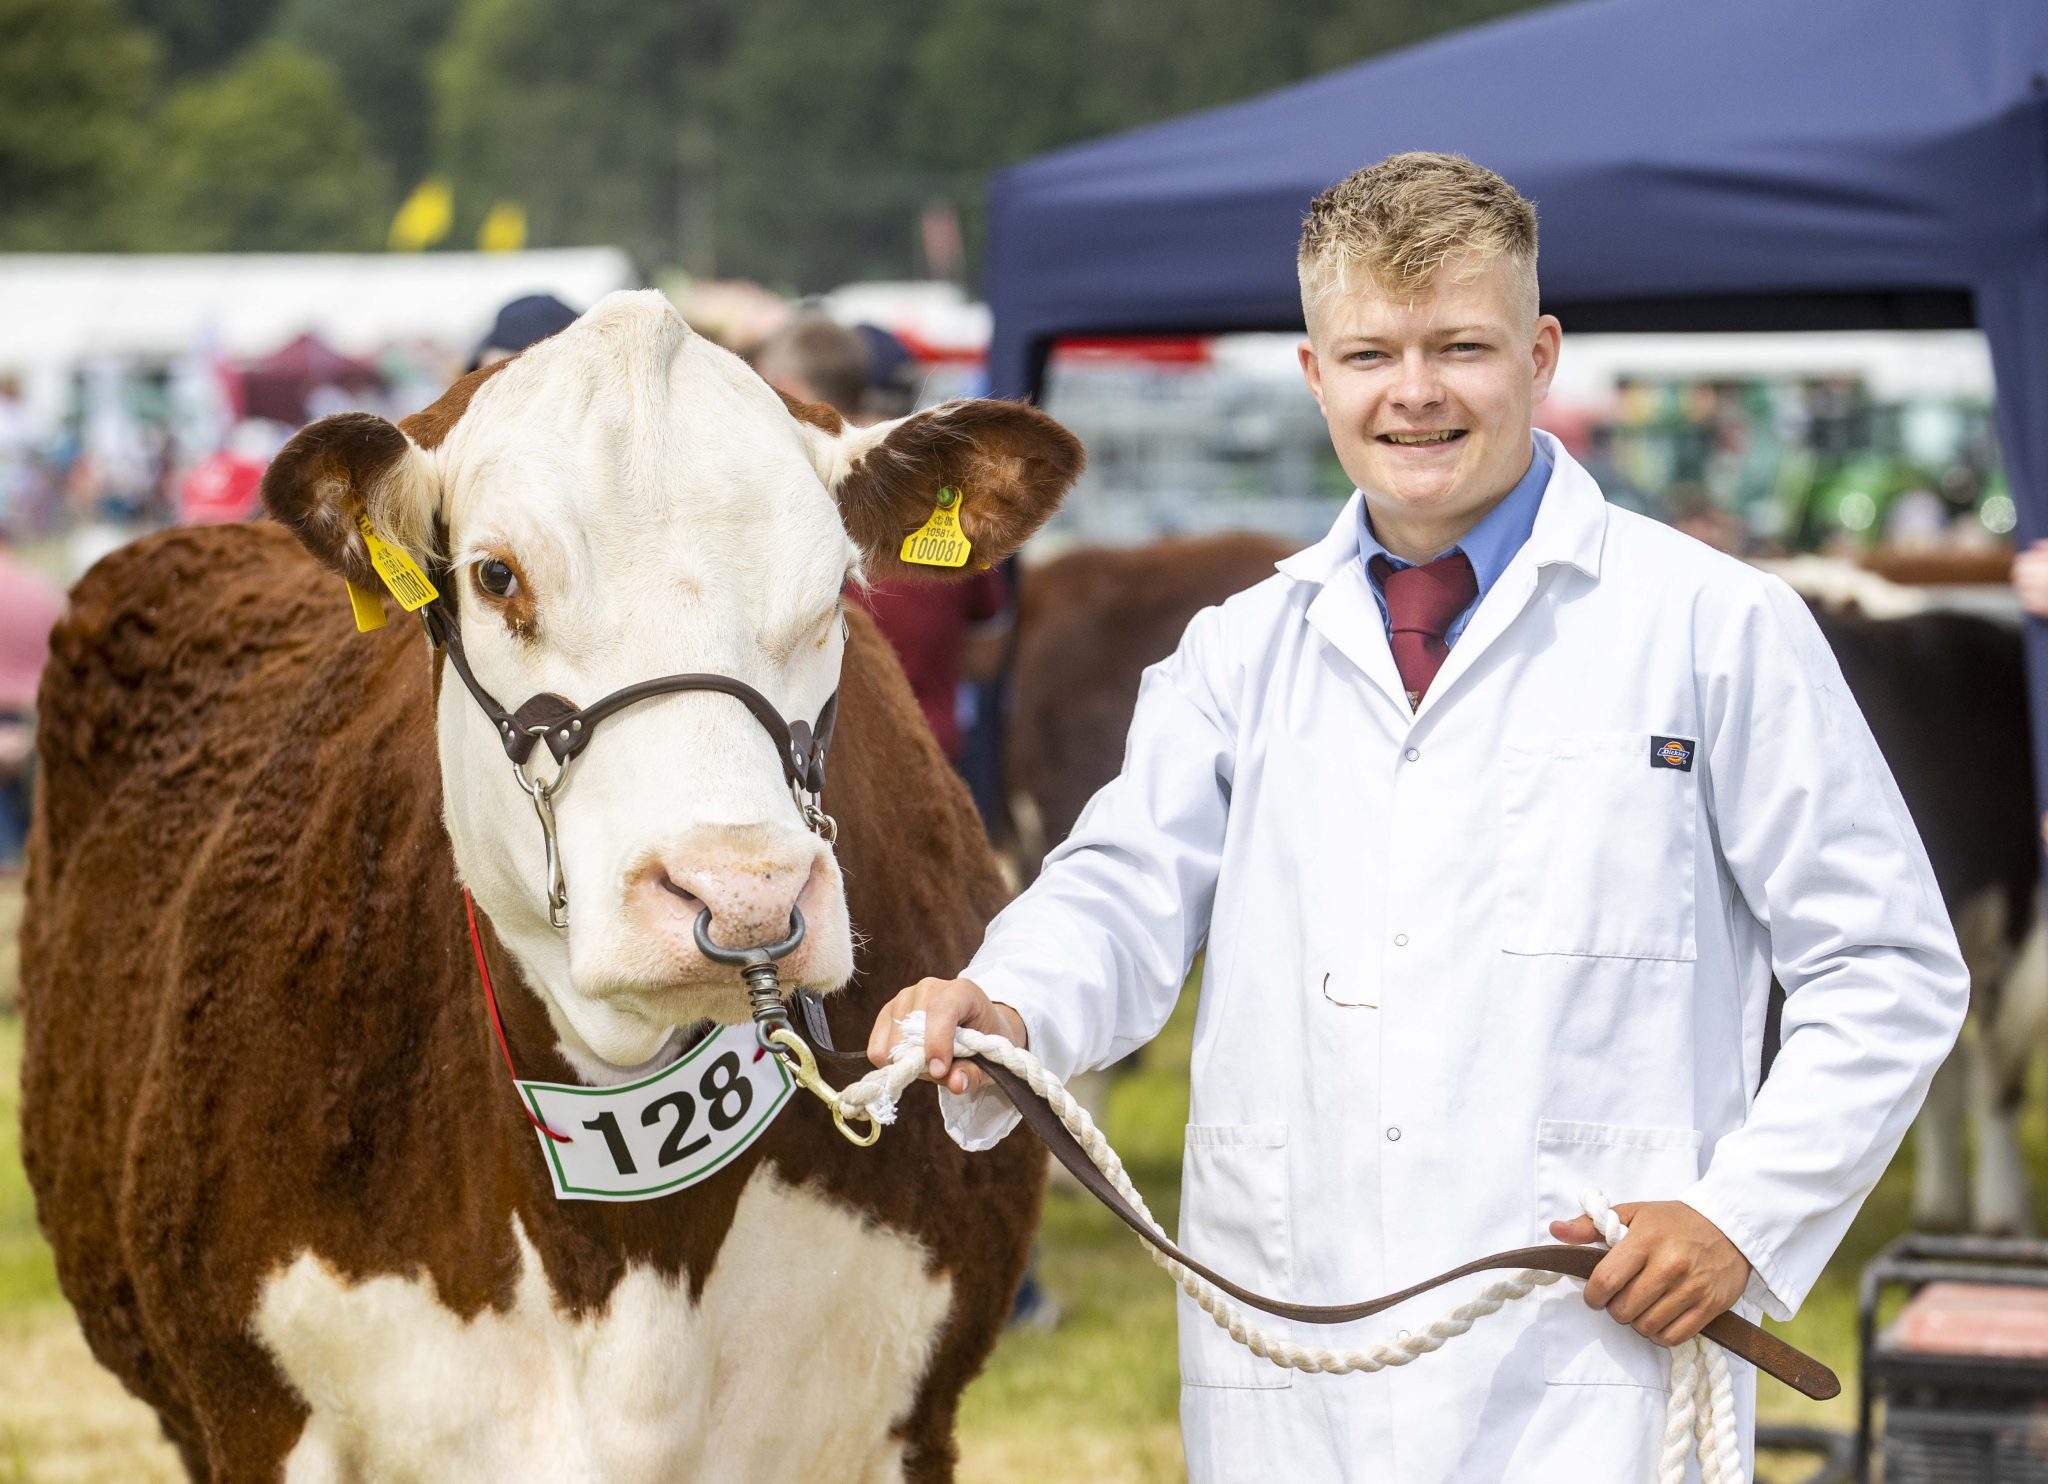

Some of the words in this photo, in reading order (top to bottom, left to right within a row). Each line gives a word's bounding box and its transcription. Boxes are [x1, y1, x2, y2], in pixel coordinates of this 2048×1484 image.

[909, 536, 964, 563] 100081
[926, 527, 956, 539] 105814
[388, 568, 432, 607] 100081
[582, 1050, 753, 1175] 128
